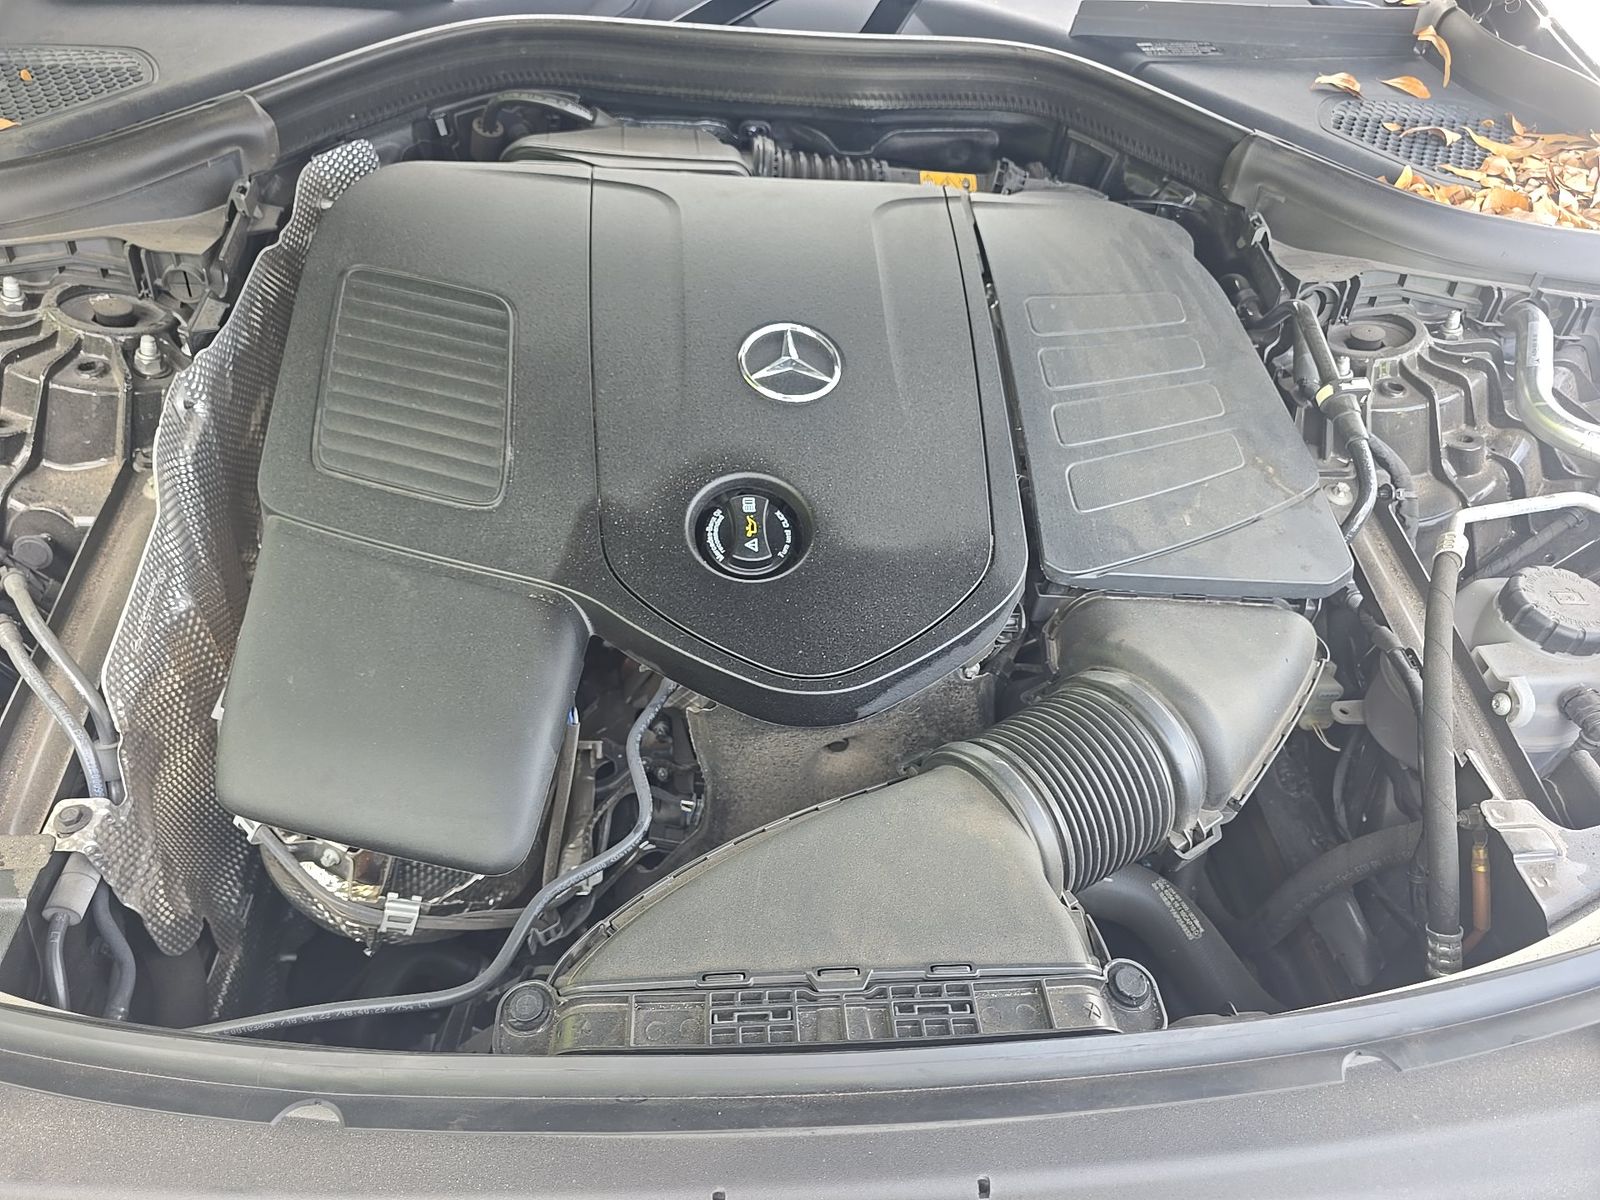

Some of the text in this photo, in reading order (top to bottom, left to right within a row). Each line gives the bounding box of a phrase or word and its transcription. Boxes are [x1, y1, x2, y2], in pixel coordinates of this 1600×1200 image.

[774, 509, 790, 528] CLICK
[706, 516, 725, 562] Mercedes-Benz
[777, 544, 790, 558] Turn
